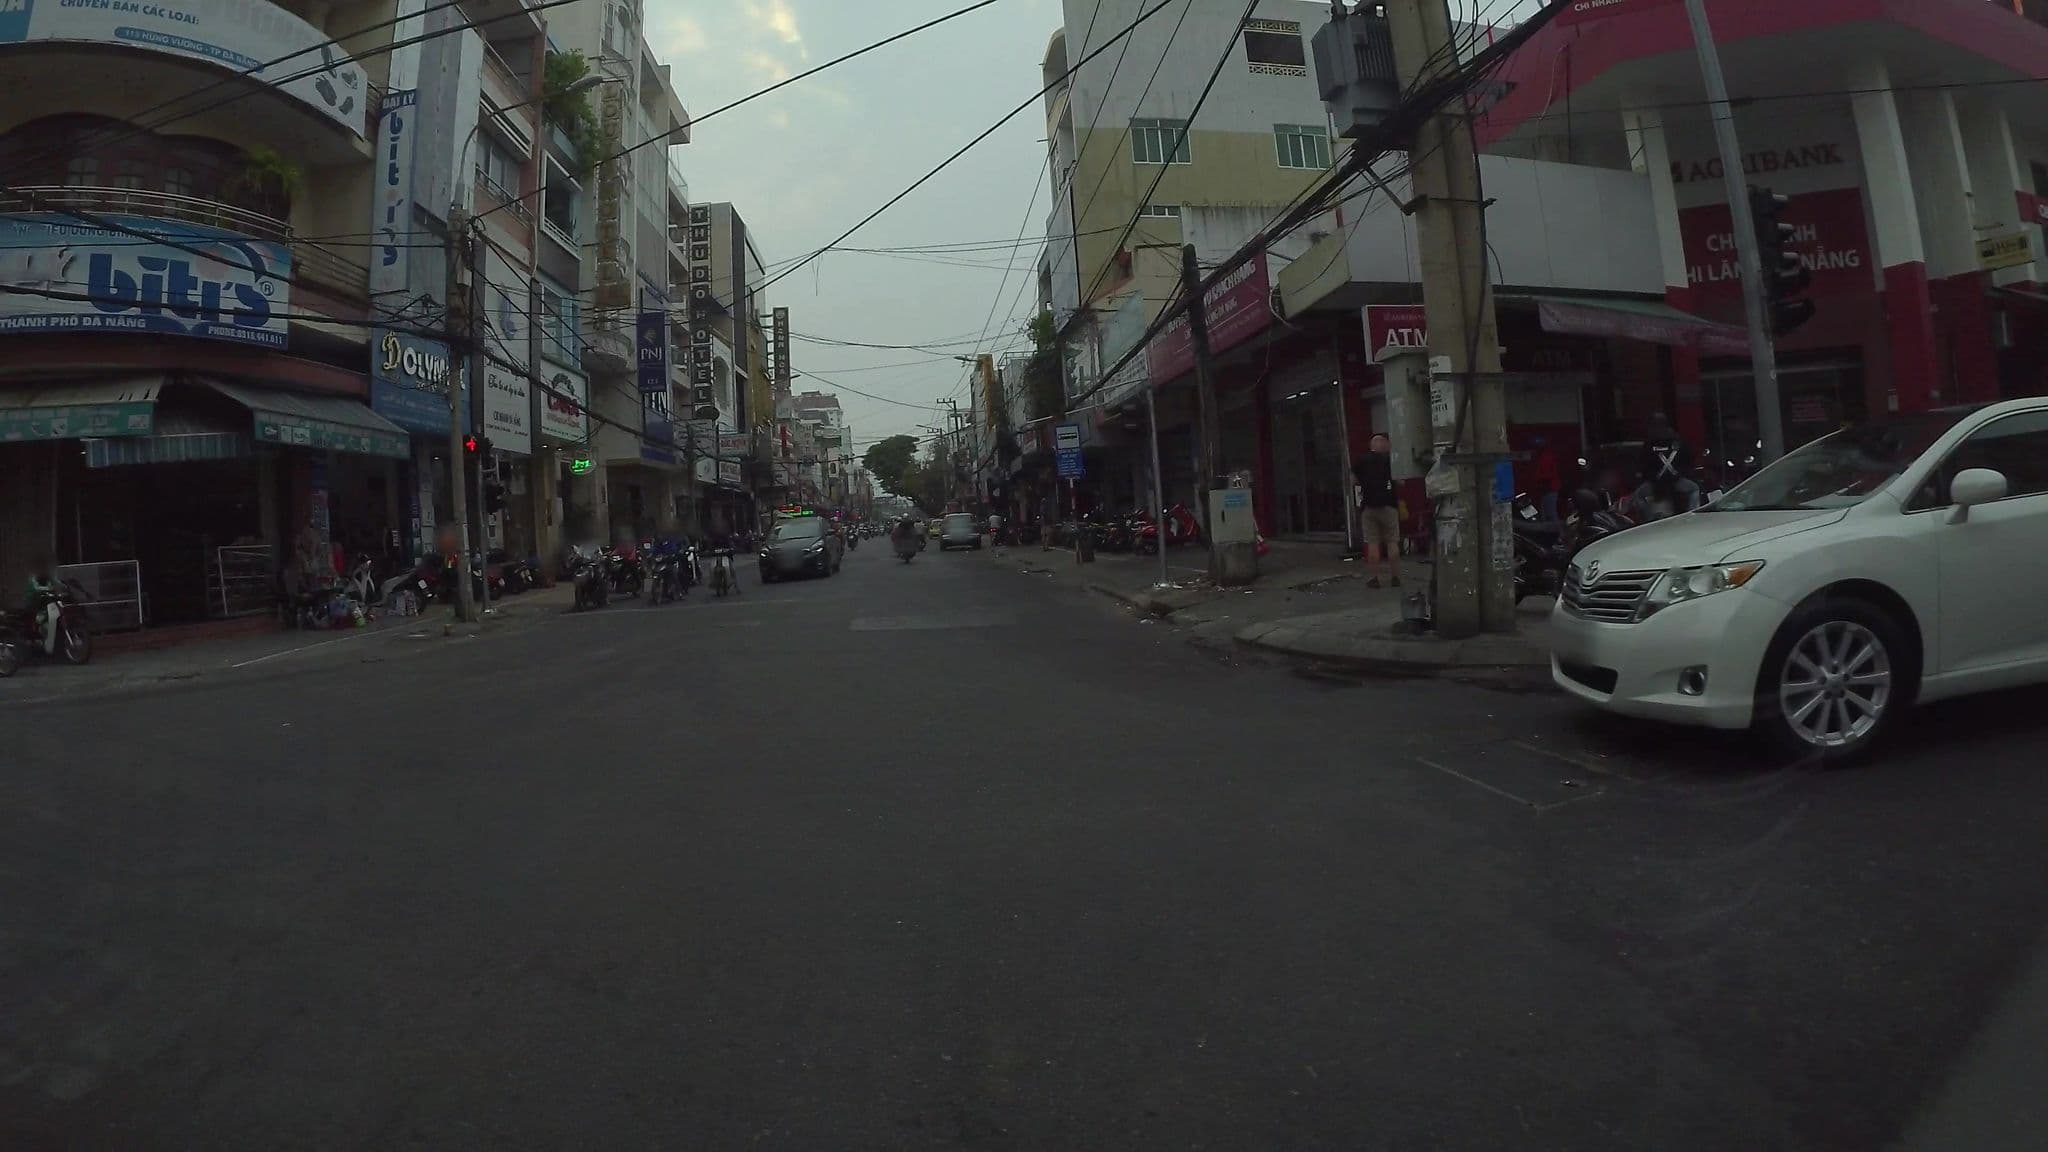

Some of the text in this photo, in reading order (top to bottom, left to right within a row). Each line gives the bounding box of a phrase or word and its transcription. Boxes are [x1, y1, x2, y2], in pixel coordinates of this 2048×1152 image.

[1574, 4, 1590, 12] CHI
[1689, 143, 1842, 181] AGIBANK
[1706, 232, 1735, 252] CH
[640, 346, 663, 361] PNJ
